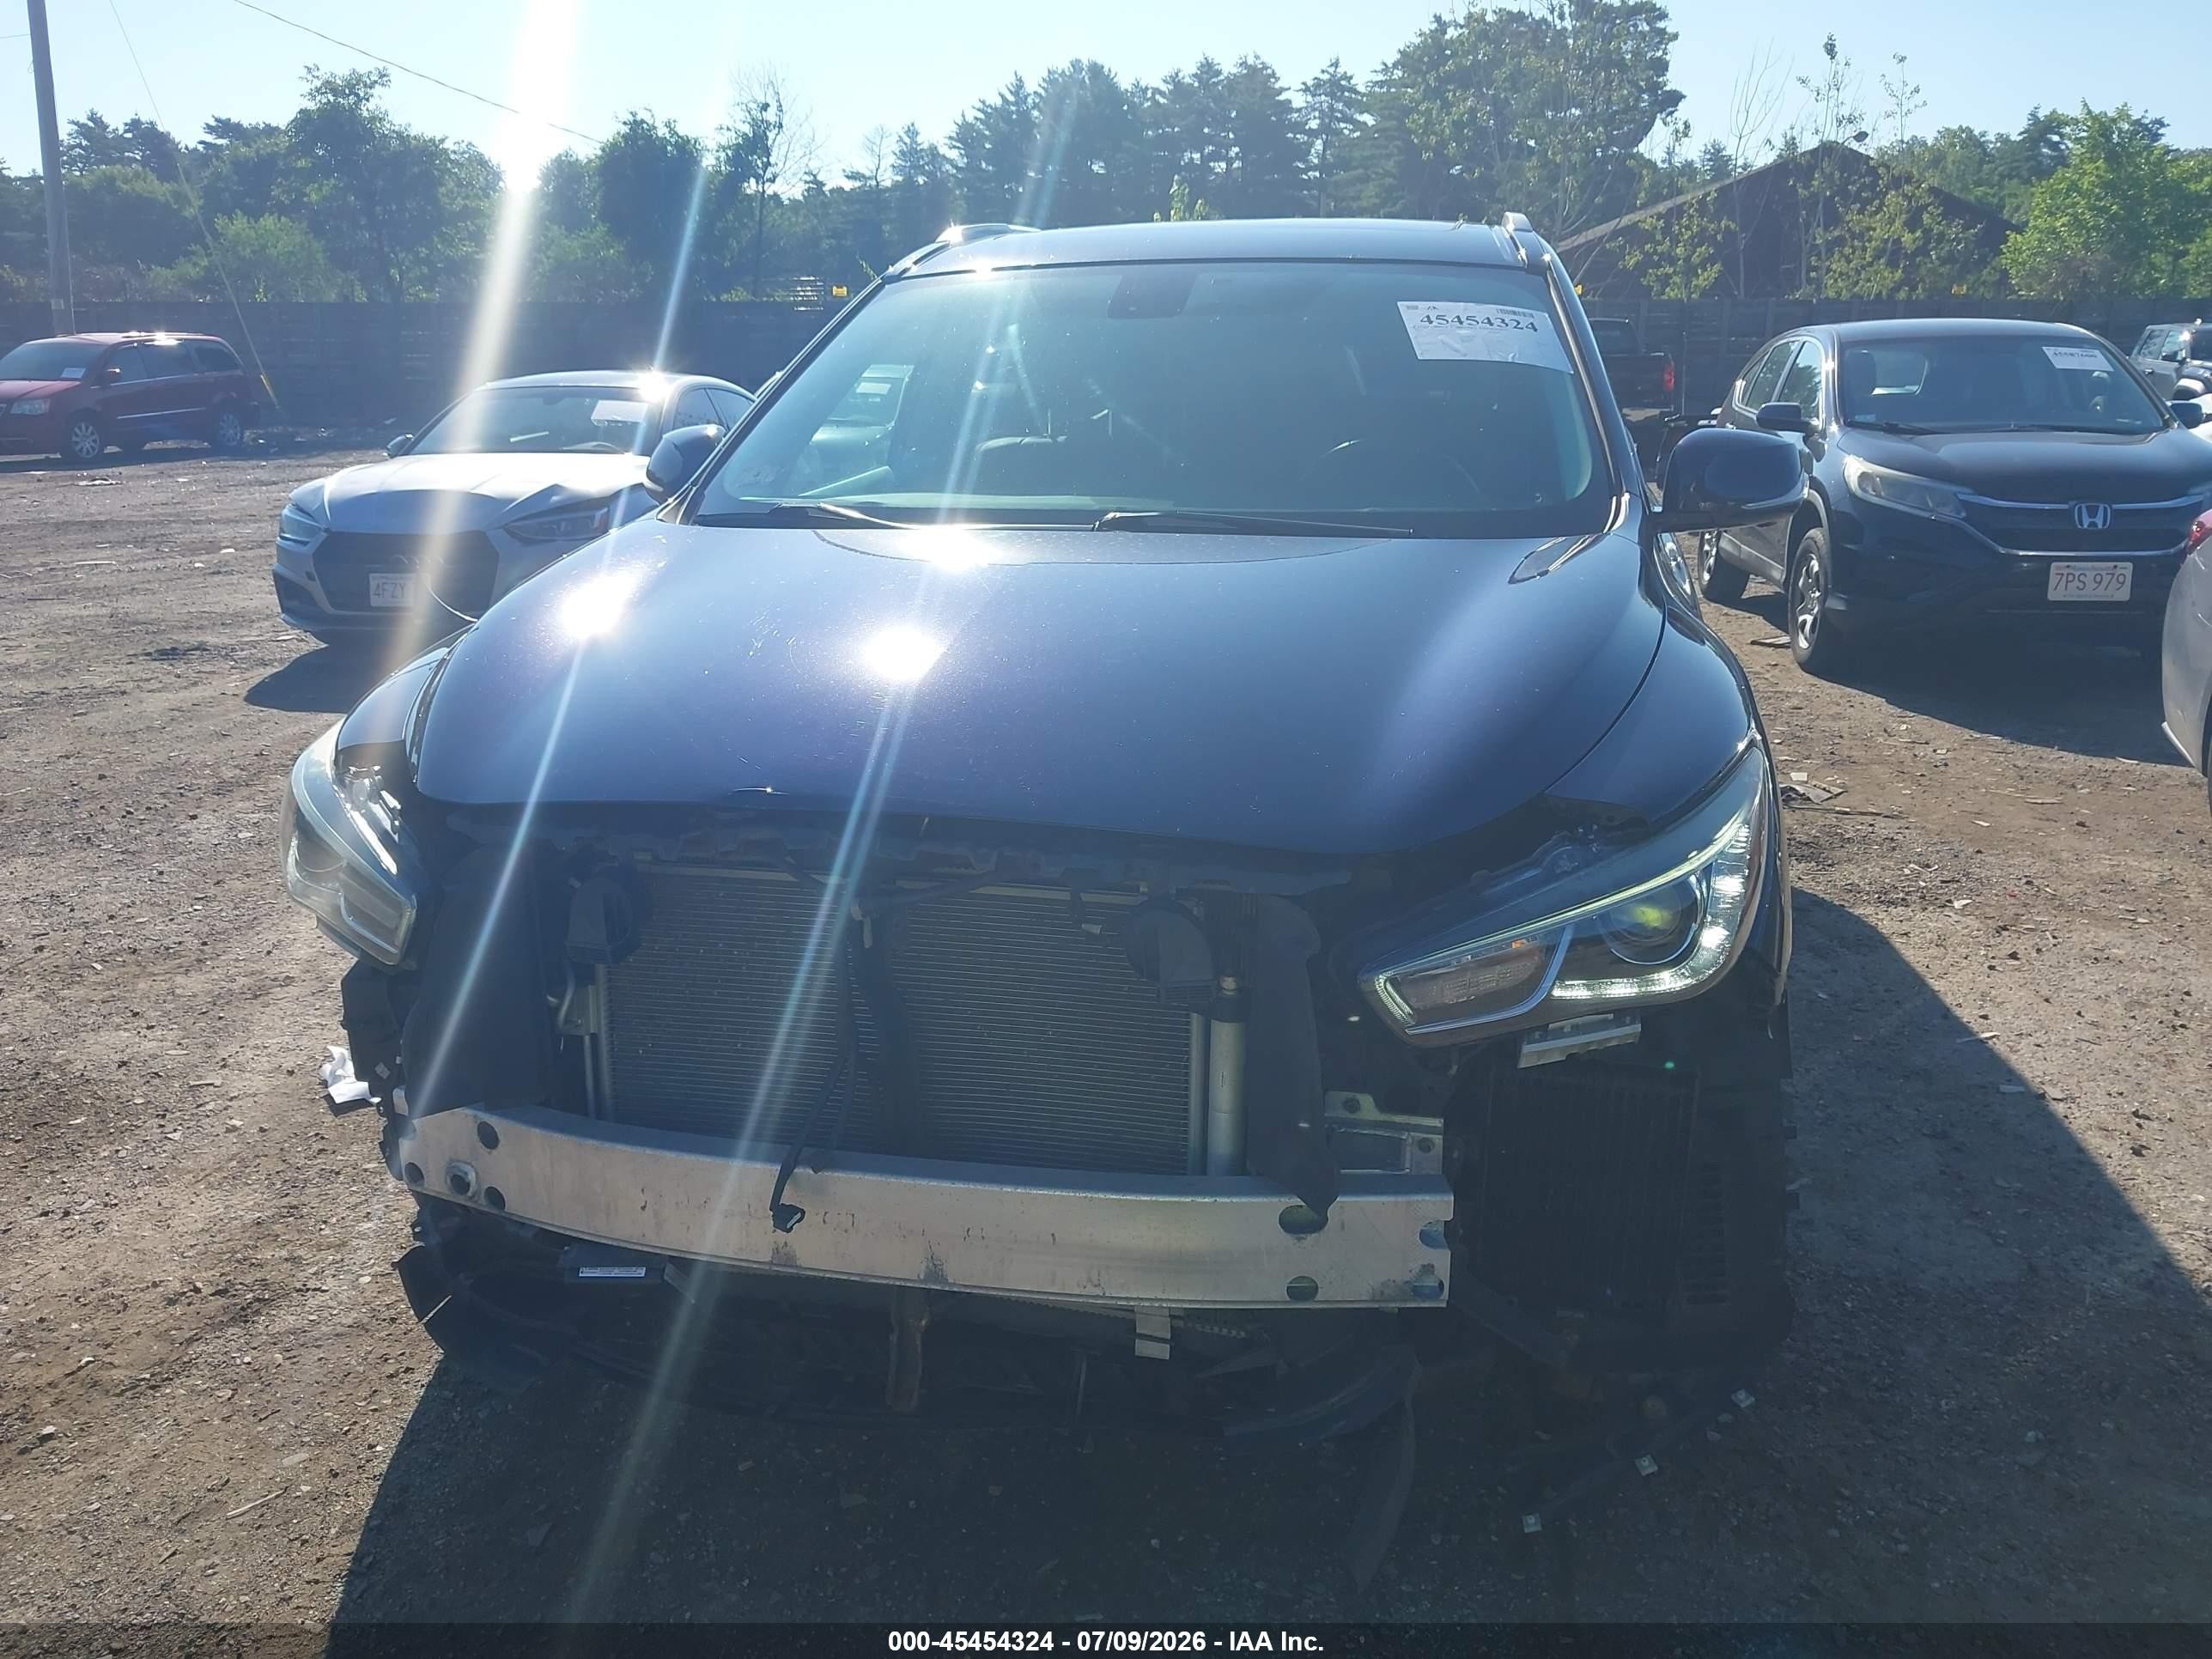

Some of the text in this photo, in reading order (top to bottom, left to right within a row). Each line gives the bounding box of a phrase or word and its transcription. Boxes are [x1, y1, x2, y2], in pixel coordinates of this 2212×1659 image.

[1420, 314, 1538, 332] 45454324
[2053, 572, 2126, 591] 7PS 979
